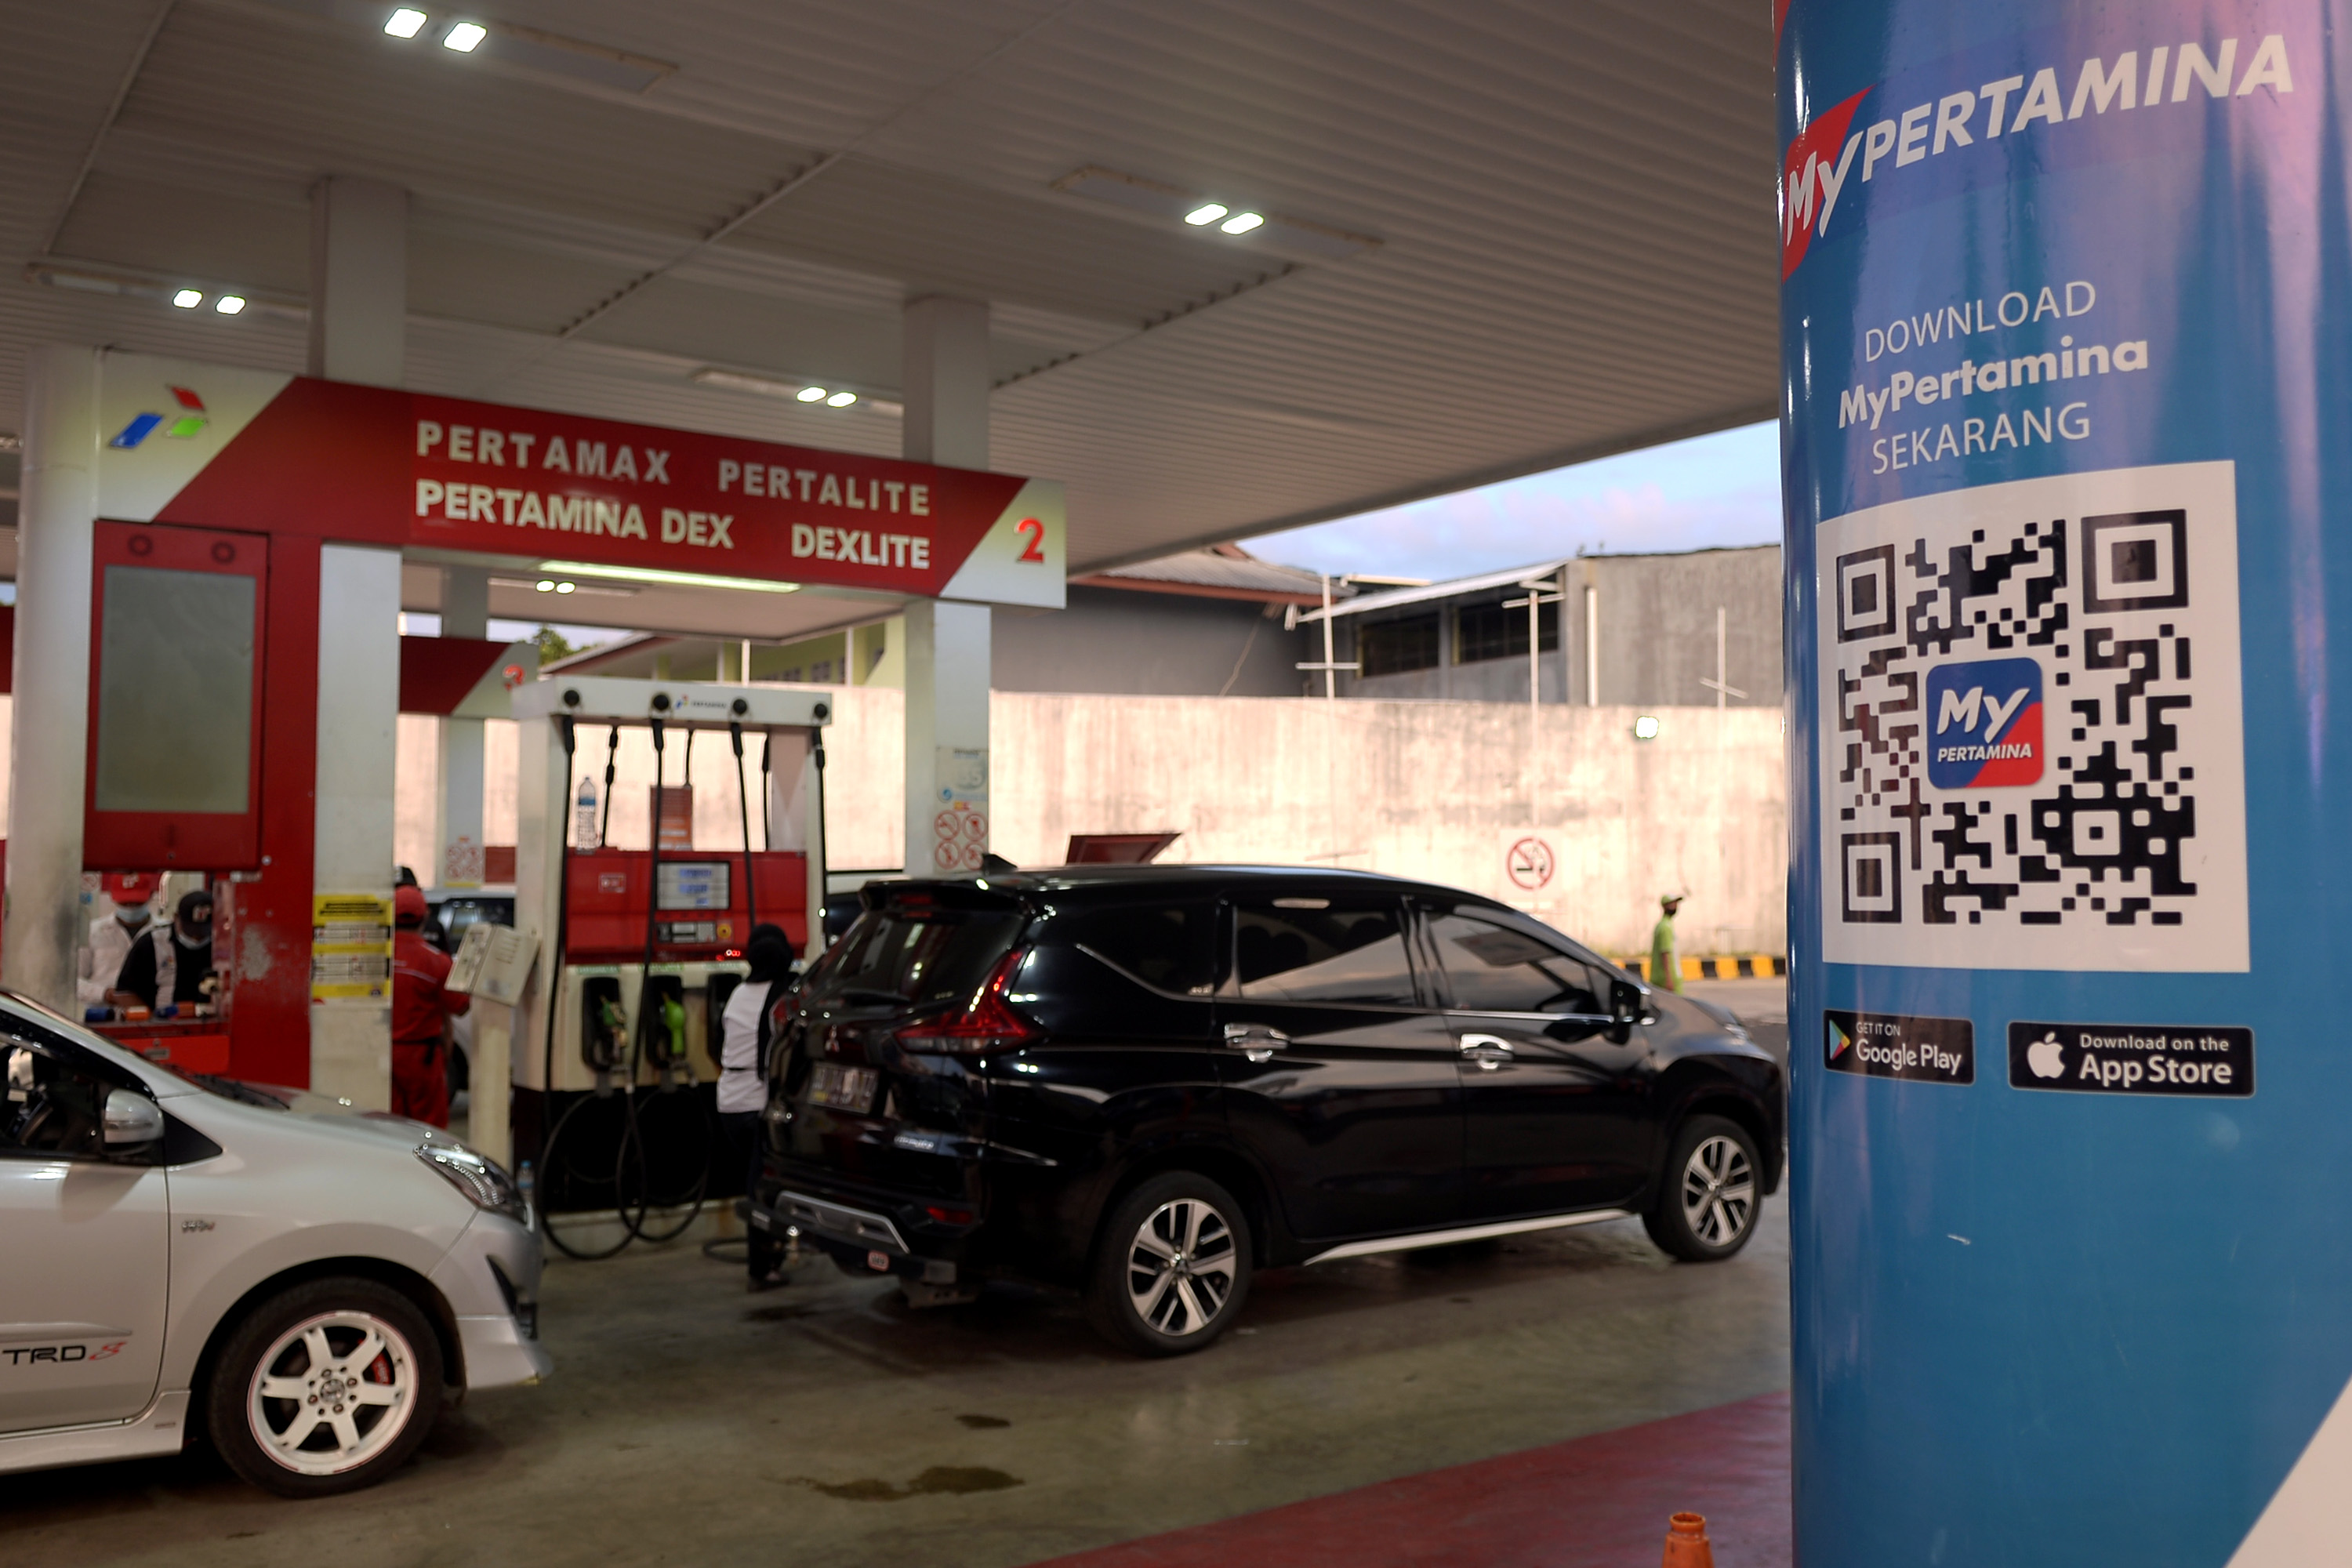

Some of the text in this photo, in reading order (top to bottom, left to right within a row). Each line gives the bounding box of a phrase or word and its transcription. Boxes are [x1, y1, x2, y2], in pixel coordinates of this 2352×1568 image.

[1865, 281, 2096, 363] DOWNLOAD
[1838, 335, 2148, 430] MyPertamina
[1872, 401, 2090, 474] SEKARANG
[416, 419, 930, 516] PERTAMAX PERTALITE
[416, 478, 930, 569] PERTAMINA DEX DEXLITE
[1014, 517, 1045, 564] 2
[1936, 686, 2031, 744] My
[1937, 743, 2032, 762] PERTAMINA
[1856, 1022, 1901, 1036] GET IT ON
[2080, 1033, 2230, 1051] Download on the
[1856, 1038, 1962, 1076] Google Play
[2079, 1054, 2232, 1087] App Store
[2, 1345, 85, 1365] TRD
